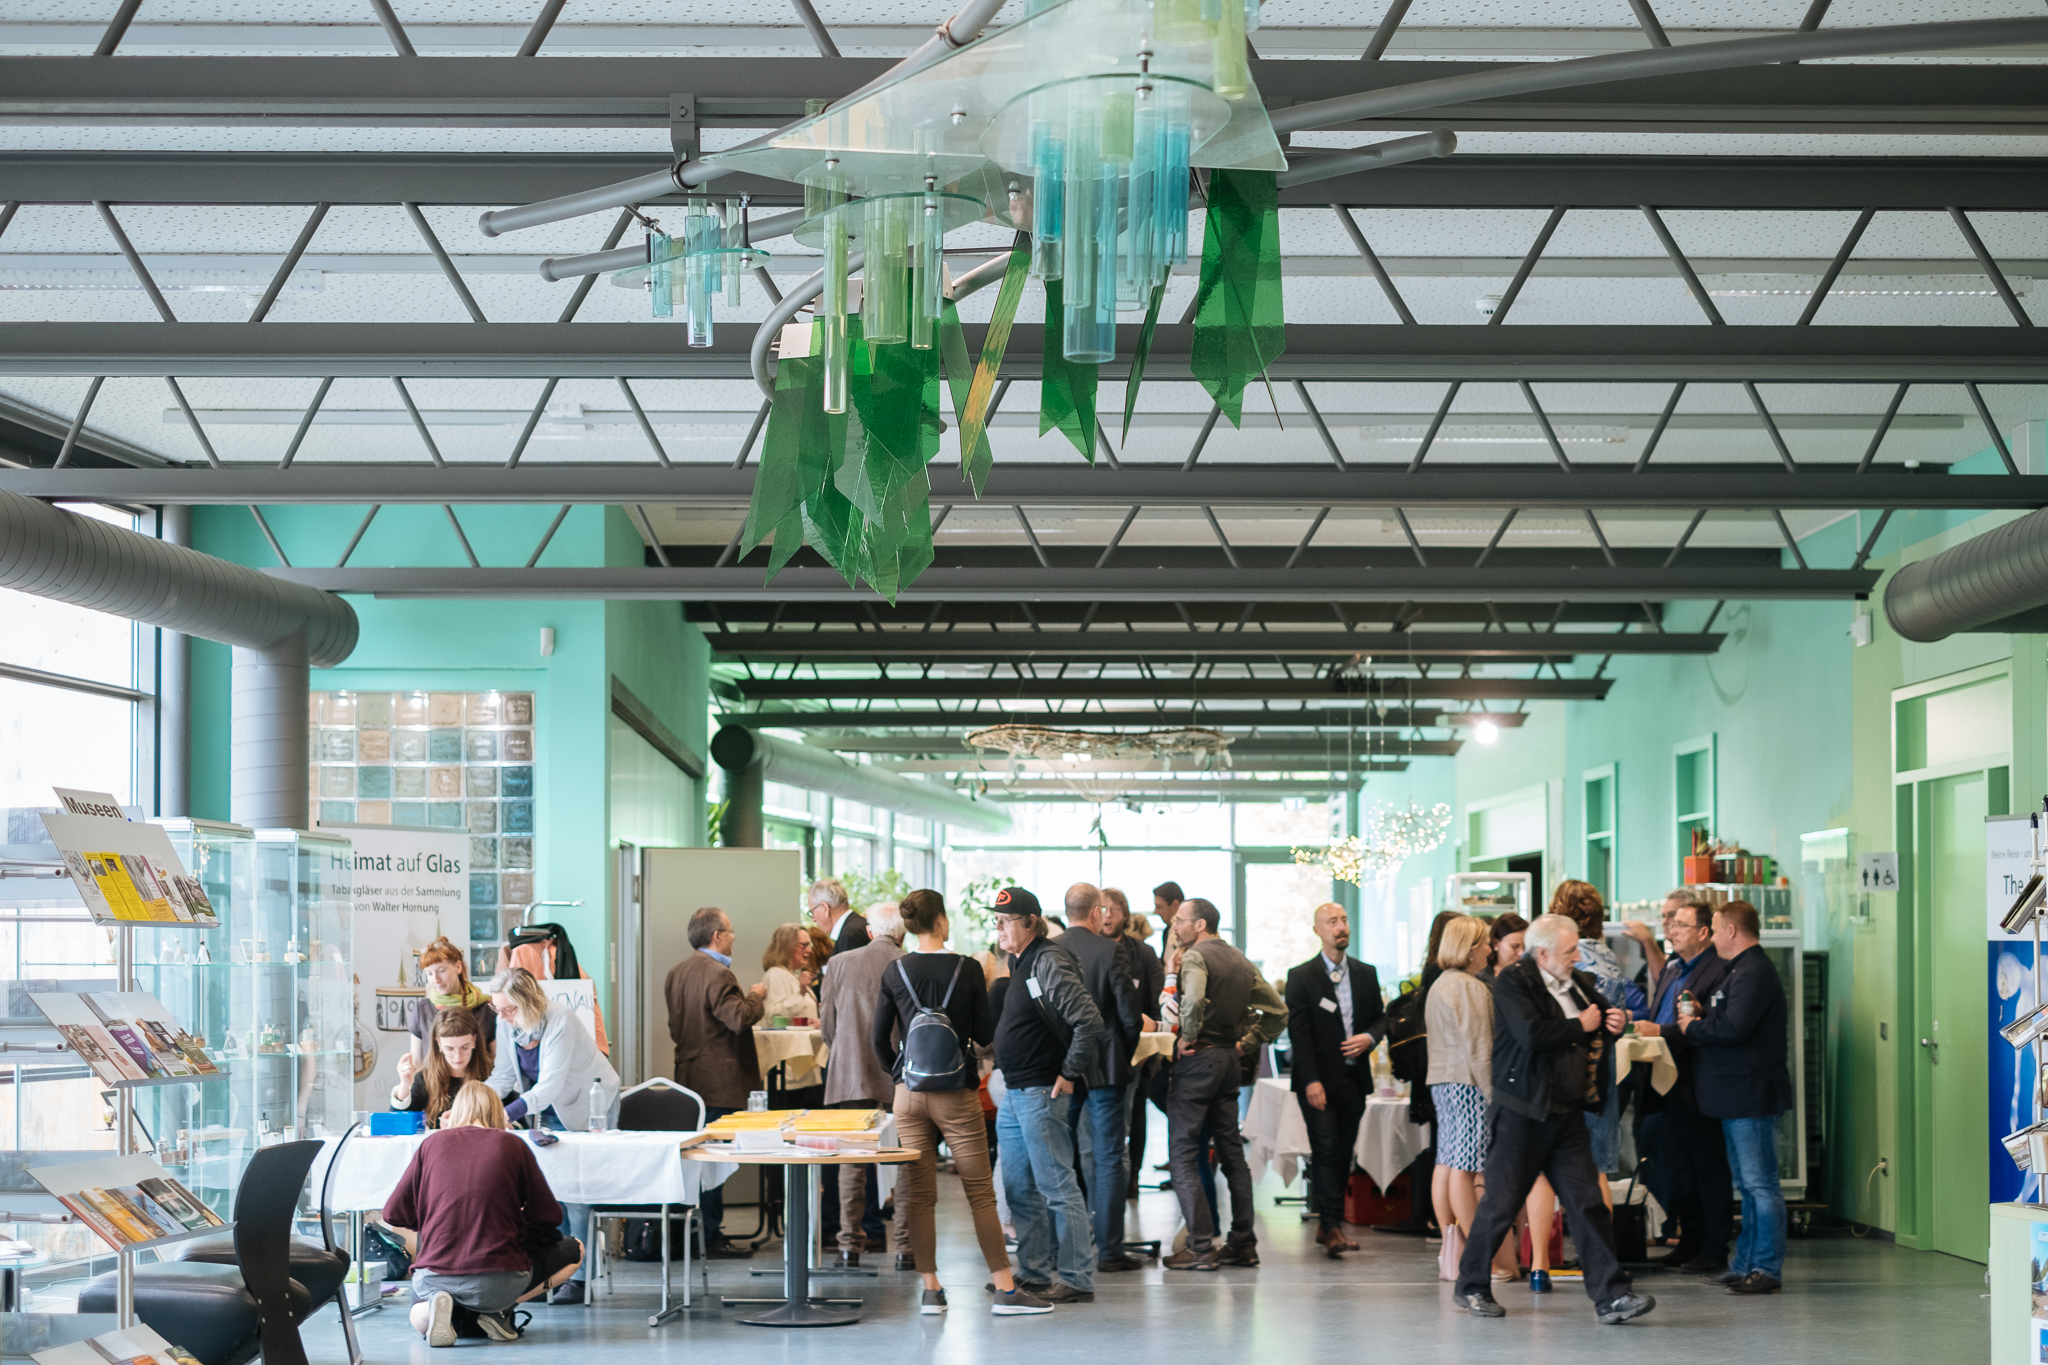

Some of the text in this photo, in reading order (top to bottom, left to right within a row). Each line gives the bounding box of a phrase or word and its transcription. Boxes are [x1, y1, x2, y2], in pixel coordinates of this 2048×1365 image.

[62, 796, 123, 818] Museen
[331, 851, 461, 873] Heimat auf Glas
[1991, 849, 2006, 860] Meine
[2006, 848, 2020, 859] Reise
[331, 884, 382, 898] Tabakgläser
[384, 887, 399, 896] aus
[401, 886, 414, 896] der
[416, 886, 461, 899] Sammlung
[2003, 874, 2024, 895] The
[354, 902, 439, 915] von Walter Hornung
